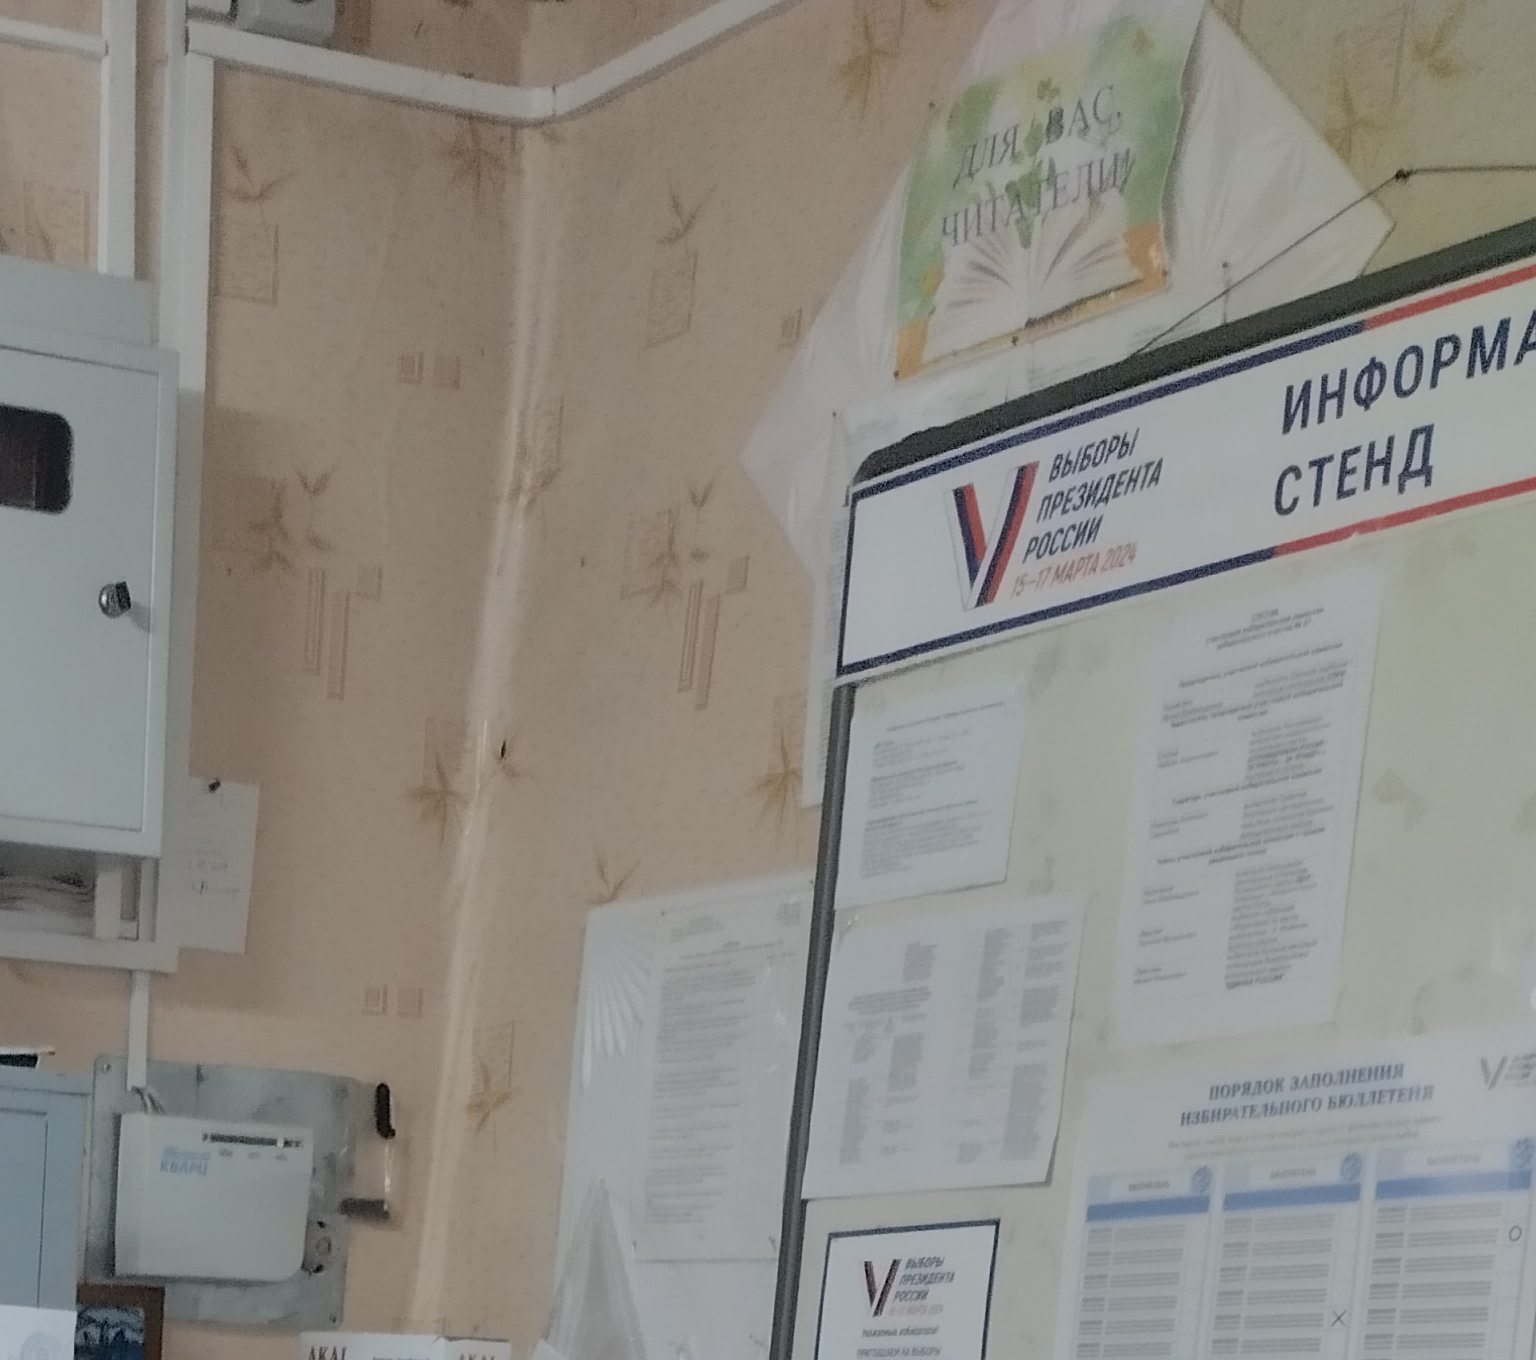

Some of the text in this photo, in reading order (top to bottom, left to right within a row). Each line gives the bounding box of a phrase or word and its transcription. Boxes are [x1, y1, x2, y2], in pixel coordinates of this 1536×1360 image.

[1048, 428, 1140, 483] ВЫБОРЫ
[1274, 423, 1435, 516] СТЕНД
[1036, 457, 1164, 523] ПРЕЗИДЕНТА
[1022, 515, 1104, 564] РОССИИ
[1052, 552, 1098, 586] МАРТА
[1180, 1084, 1435, 1127] ИЗБИРАТЕЛЬНОГО БЮЛЛЕТЕНЯ
[1209, 1063, 1405, 1101] ПОРЯДОК ЗАПОЛНЕНИЯ
